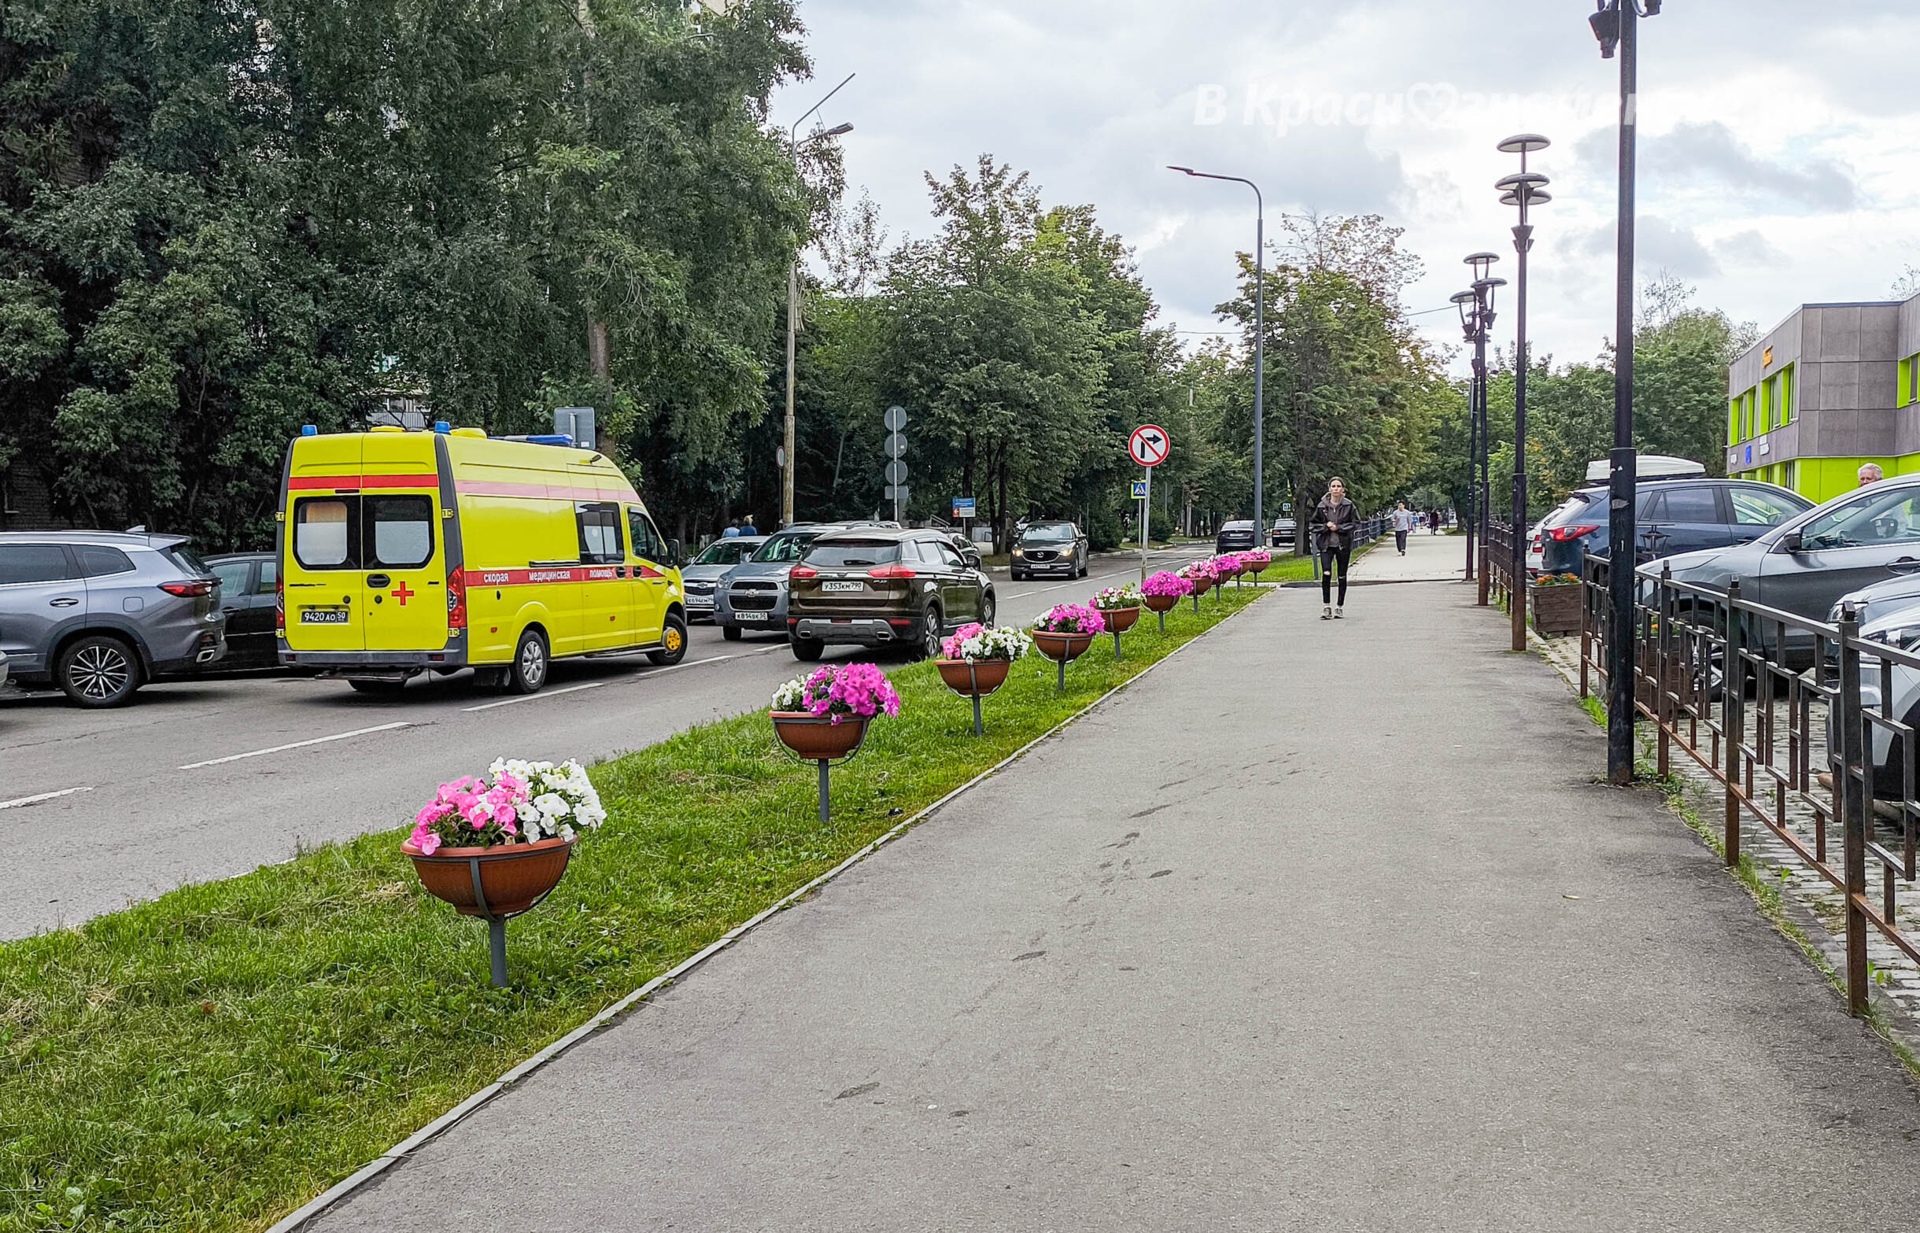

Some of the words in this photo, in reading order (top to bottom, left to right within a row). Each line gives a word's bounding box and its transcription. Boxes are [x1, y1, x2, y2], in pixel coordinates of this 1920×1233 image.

[483, 572, 509, 585] скорая
[529, 570, 570, 583] медицинская
[589, 568, 613, 579] помощь
